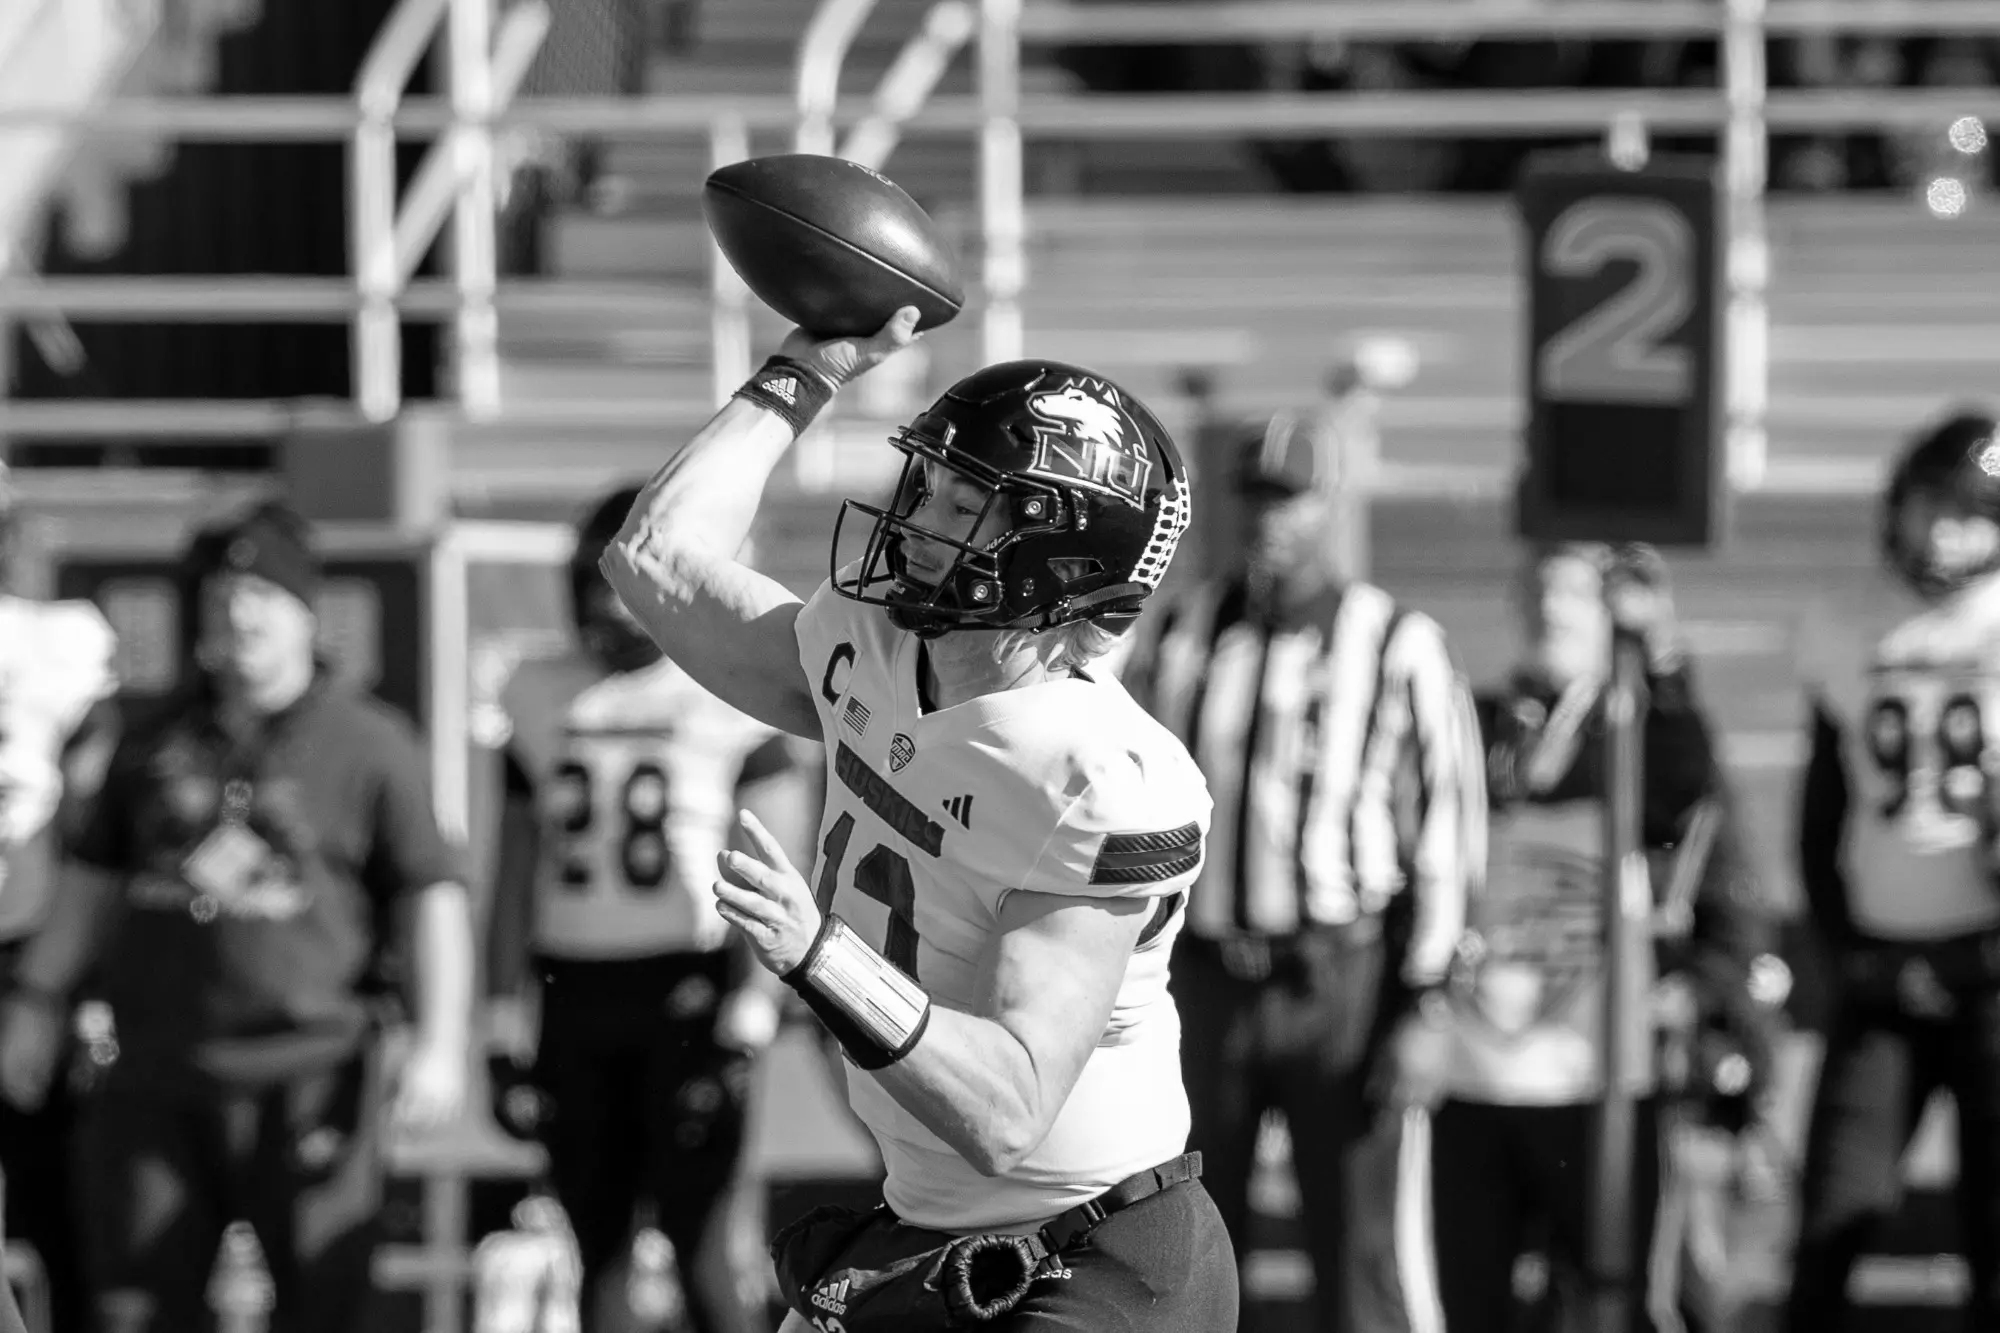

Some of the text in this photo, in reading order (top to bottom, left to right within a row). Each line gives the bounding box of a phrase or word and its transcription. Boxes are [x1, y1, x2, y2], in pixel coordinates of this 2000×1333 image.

[1540, 197, 1696, 403] 2
[1027, 425, 1153, 513] NIU
[822, 641, 856, 707] C
[811, 1293, 847, 1315] adidas
